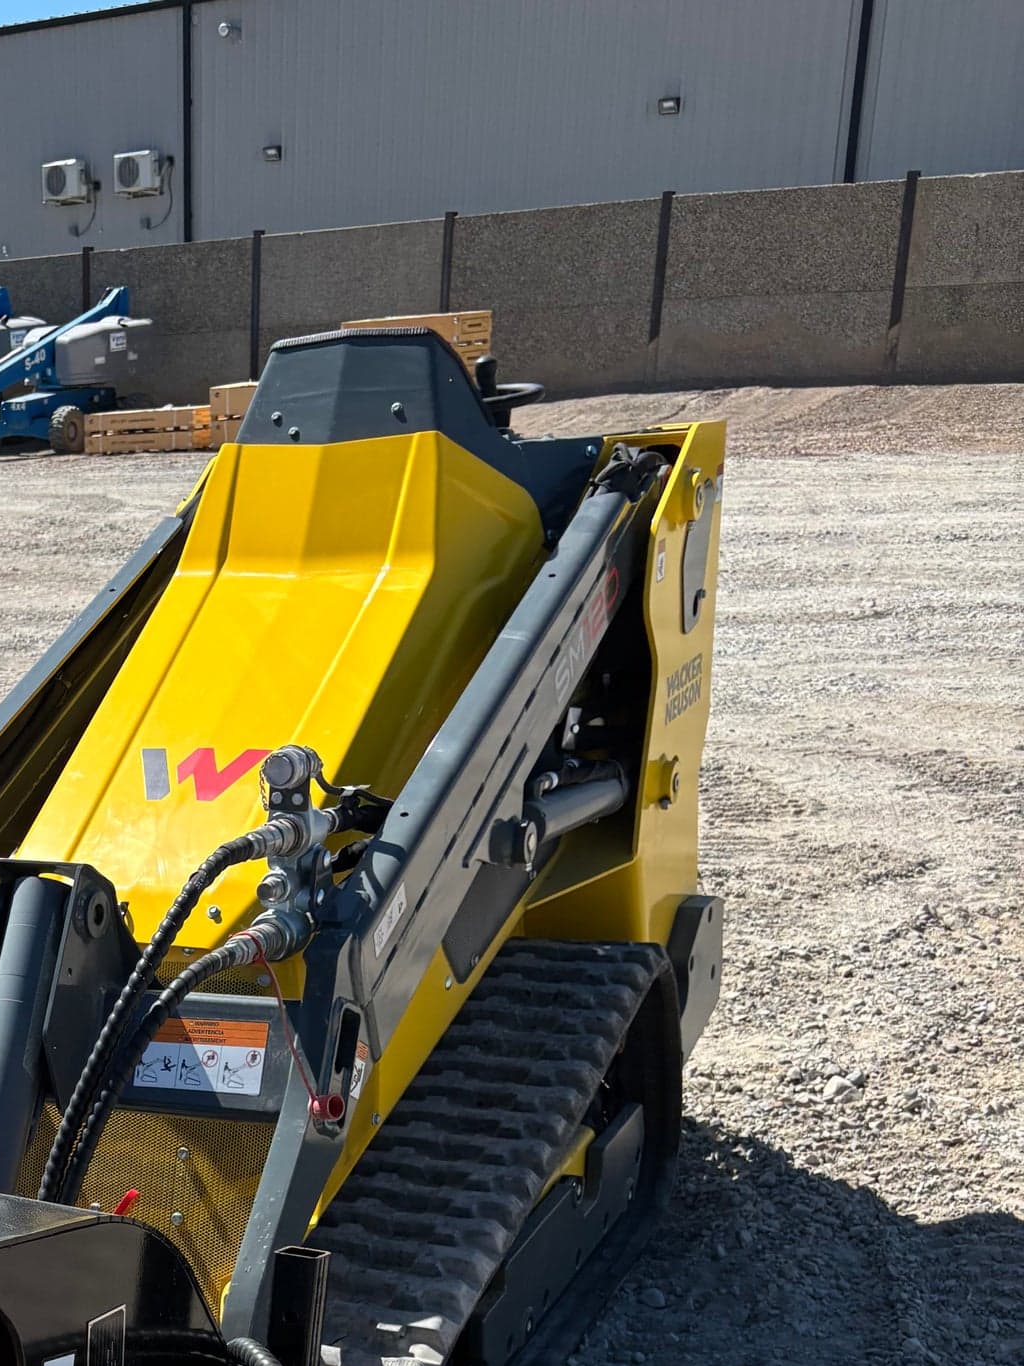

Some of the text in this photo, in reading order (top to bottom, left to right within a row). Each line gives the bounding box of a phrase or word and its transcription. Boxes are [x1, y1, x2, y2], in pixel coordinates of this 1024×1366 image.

[25, 349, 47, 371] S-40
[555, 567, 619, 703] SM120
[666, 652, 703, 699] WACKER
[664, 675, 702, 727] NEUSON
